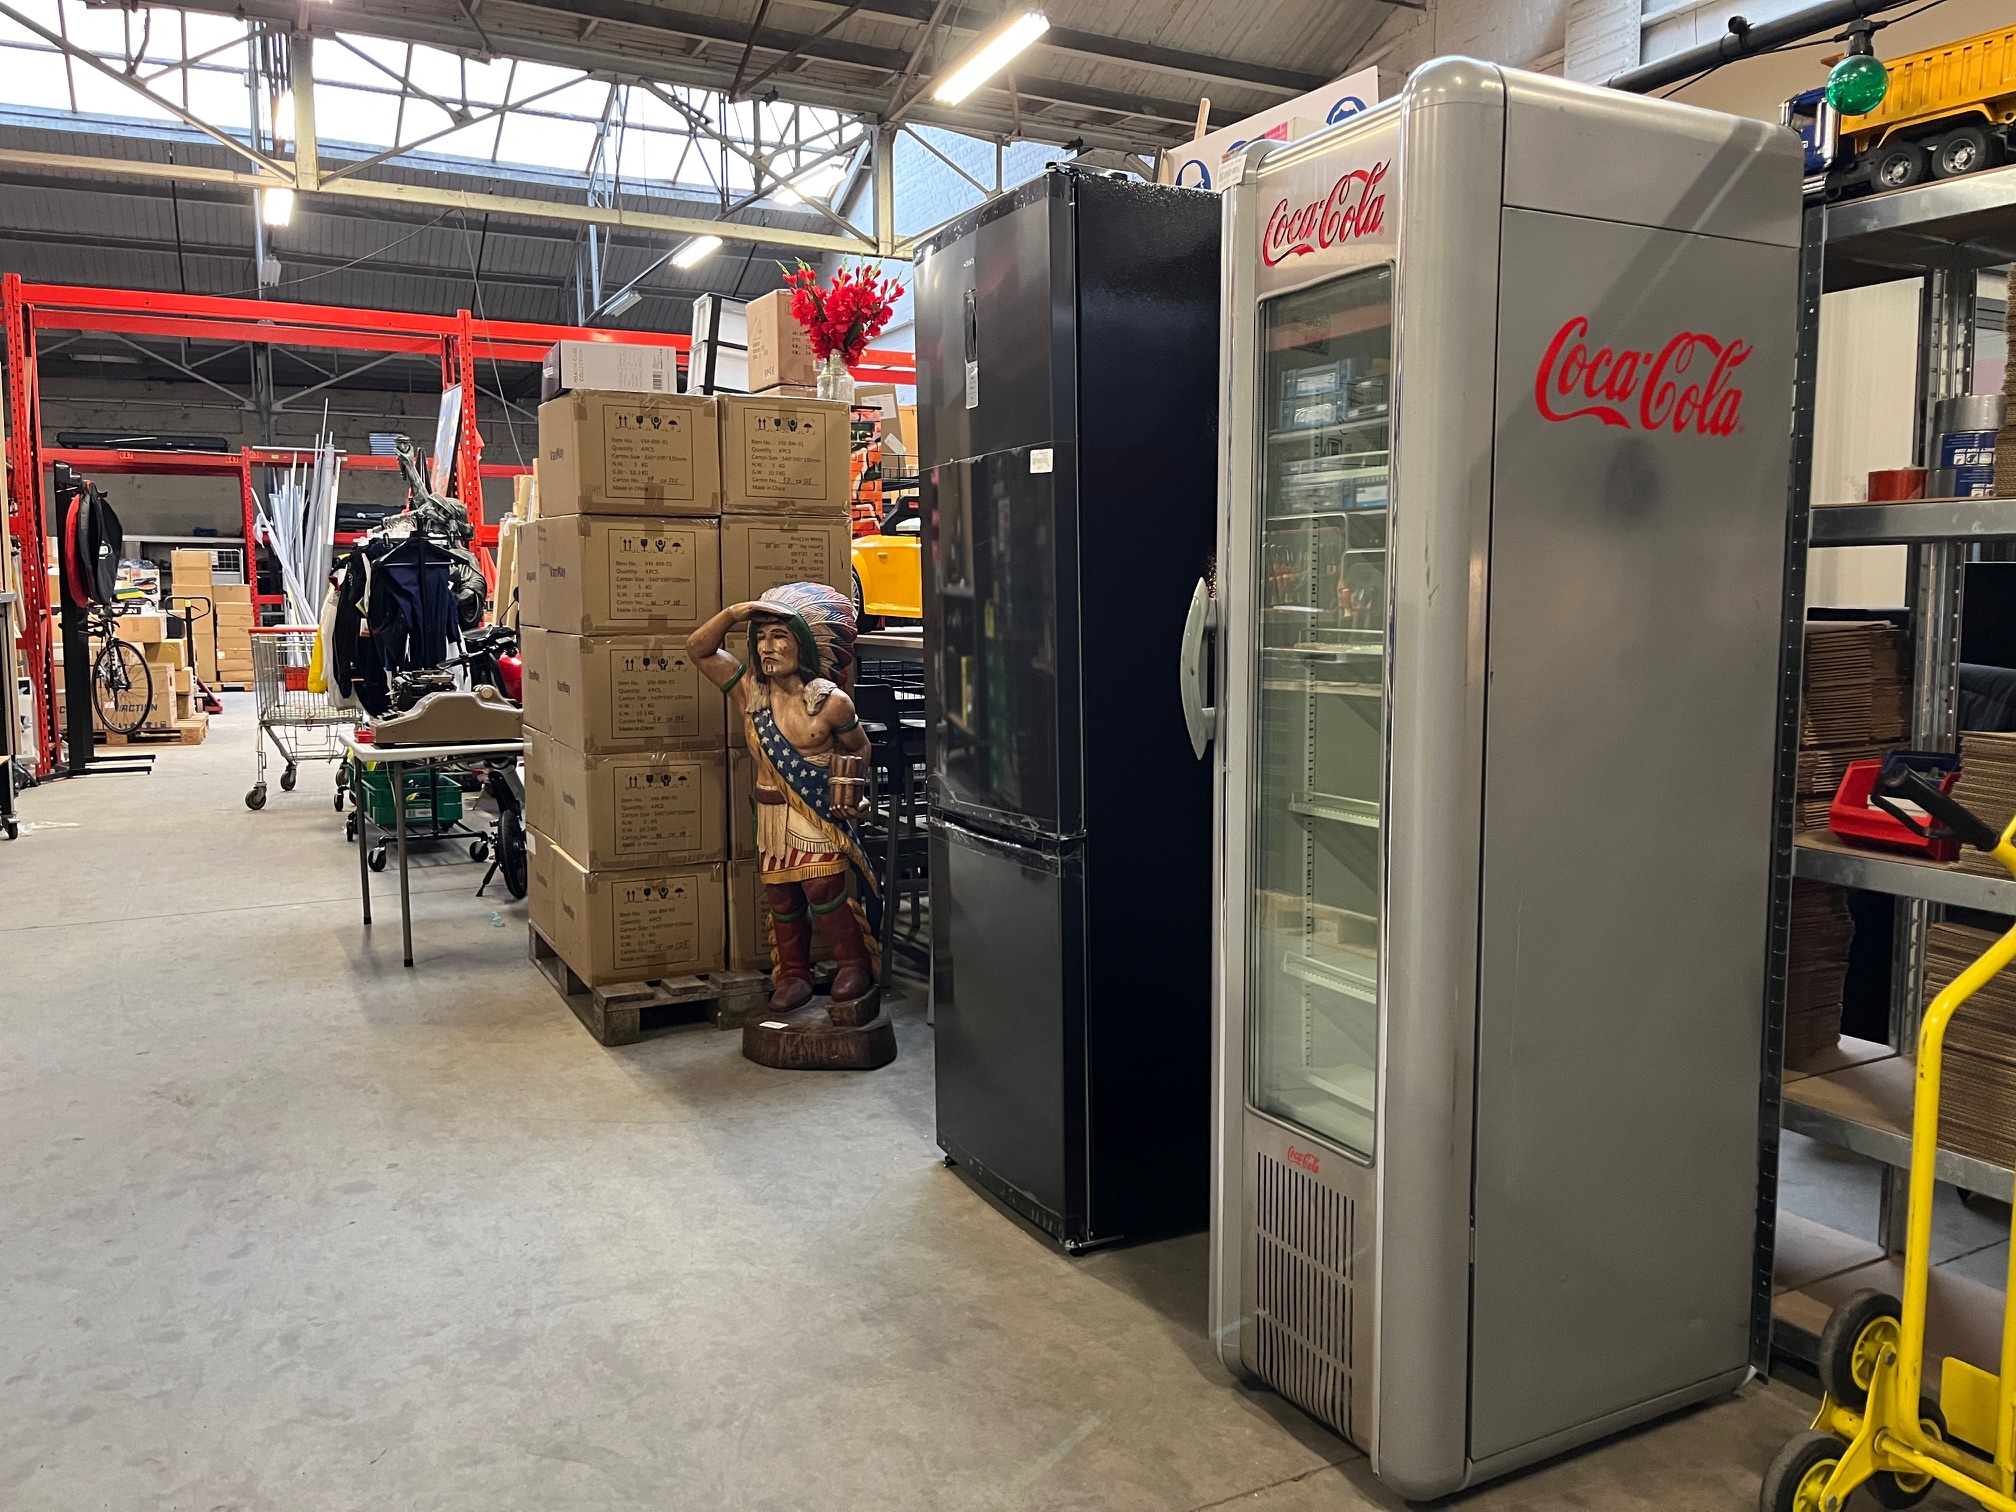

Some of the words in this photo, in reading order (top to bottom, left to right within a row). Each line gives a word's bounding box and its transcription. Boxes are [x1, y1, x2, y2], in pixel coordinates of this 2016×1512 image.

[1263, 158, 1391, 267] Coca-Cola
[1535, 316, 1753, 437] Coca-Cola
[1287, 1146, 1320, 1174] Coca-Cola
